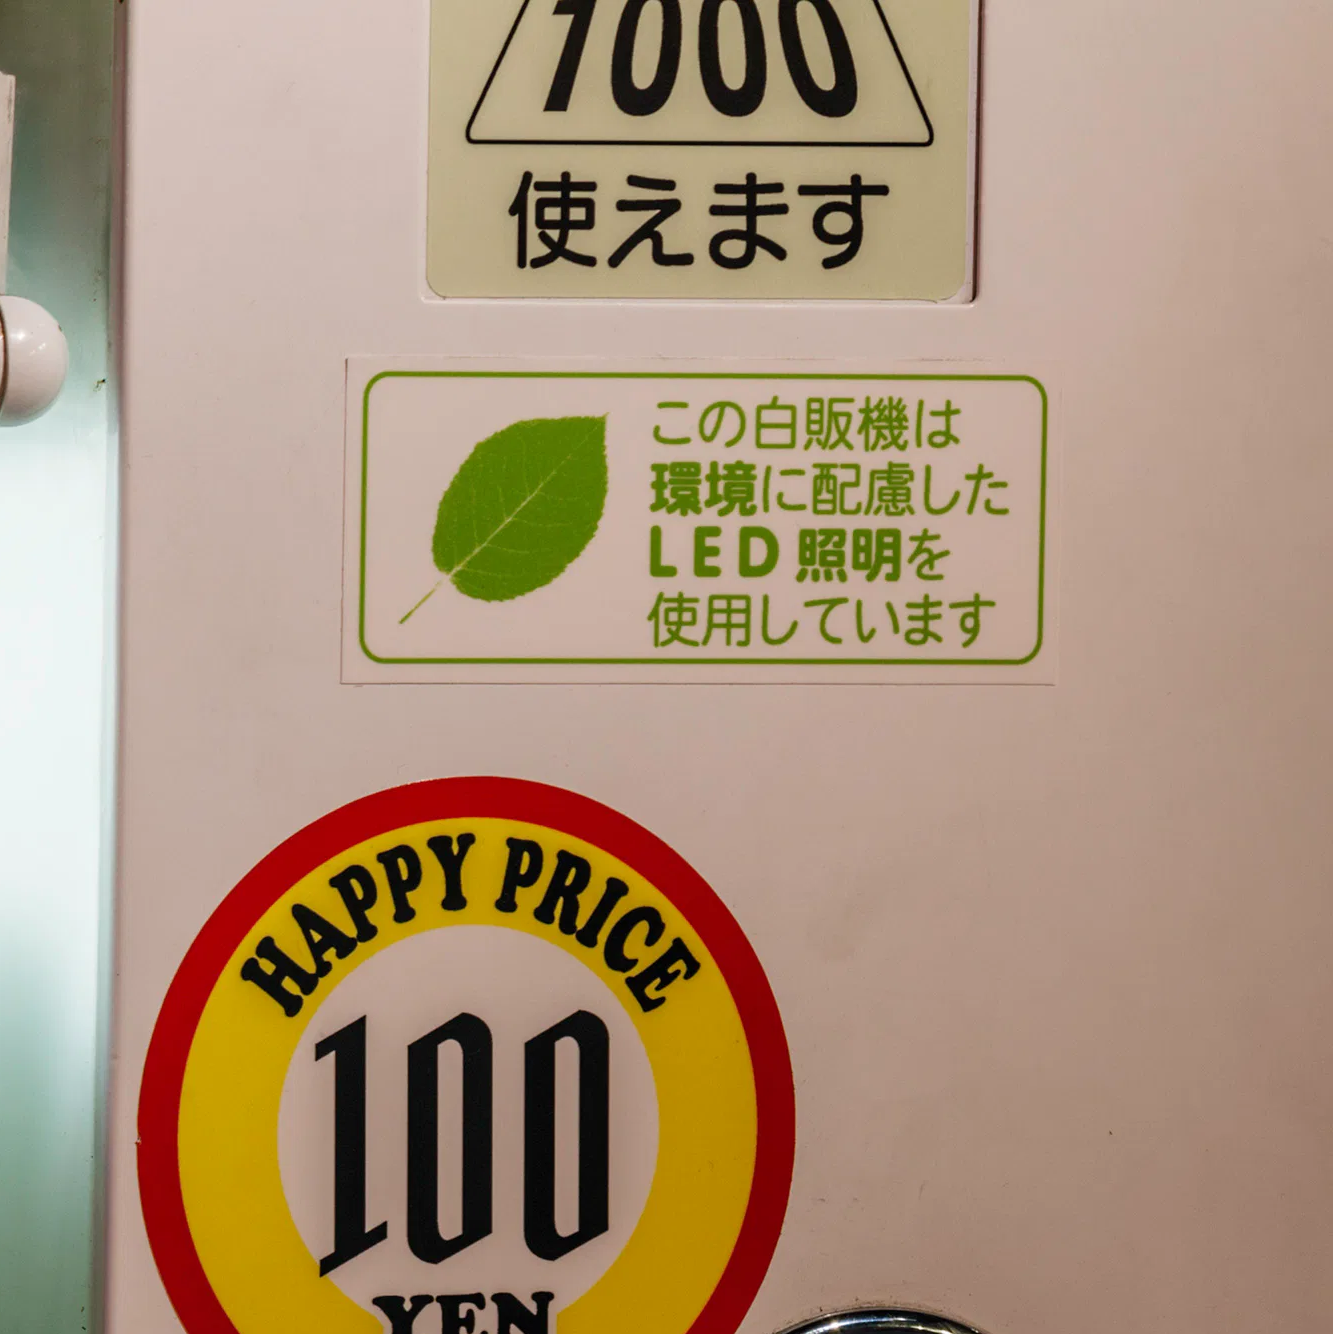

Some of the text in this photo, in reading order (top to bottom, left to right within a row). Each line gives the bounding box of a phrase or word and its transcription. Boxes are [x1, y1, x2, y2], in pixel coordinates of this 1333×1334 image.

[542, 0, 858, 118] 1000
[507, 170, 890, 270] 使えます
[649, 462, 1010, 517] 環境に配慮した
[646, 592, 996, 649] 使用しています
[240, 832, 702, 1018] HAPPY PRICE
[314, 1009, 610, 1278] 100
